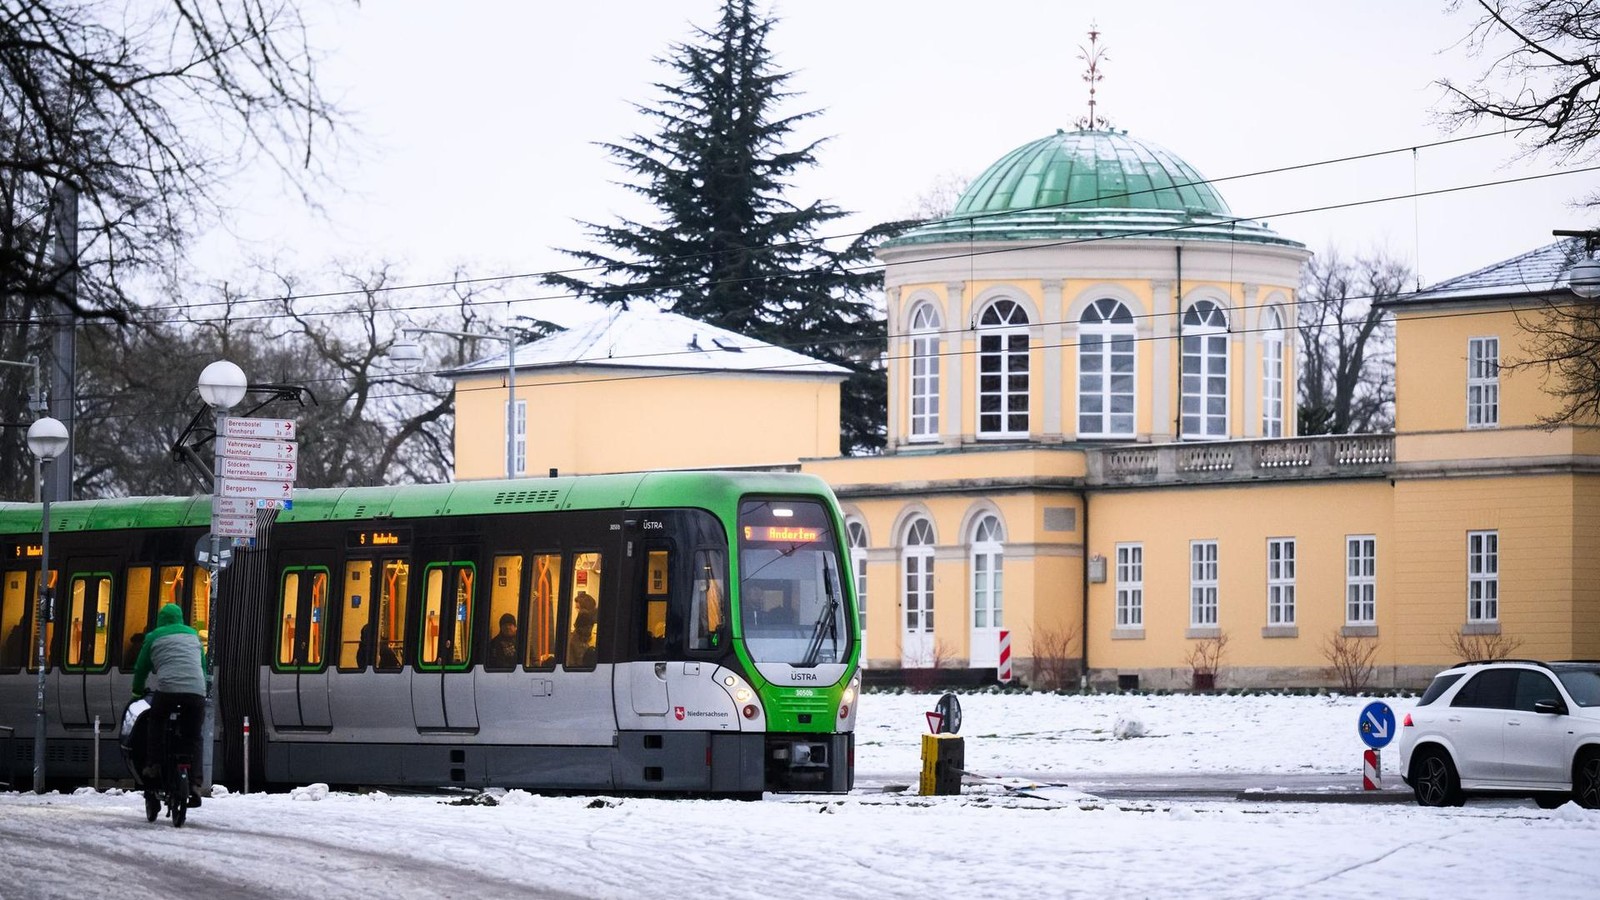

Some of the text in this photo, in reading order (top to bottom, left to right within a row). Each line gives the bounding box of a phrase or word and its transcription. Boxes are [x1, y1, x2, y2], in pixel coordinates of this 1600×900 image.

[226, 469, 267, 477] Herrenhausen
[226, 485, 257, 493] Berggarten
[643, 519, 663, 530] ÜSTRA
[744, 526, 817, 541] 5 Anderten
[360, 533, 366, 545] 5
[16, 545, 21, 556] 5
[790, 671, 817, 681] ÜSTRA
[795, 689, 814, 697] 3050b
[687, 710, 729, 718] Niedersachsen
